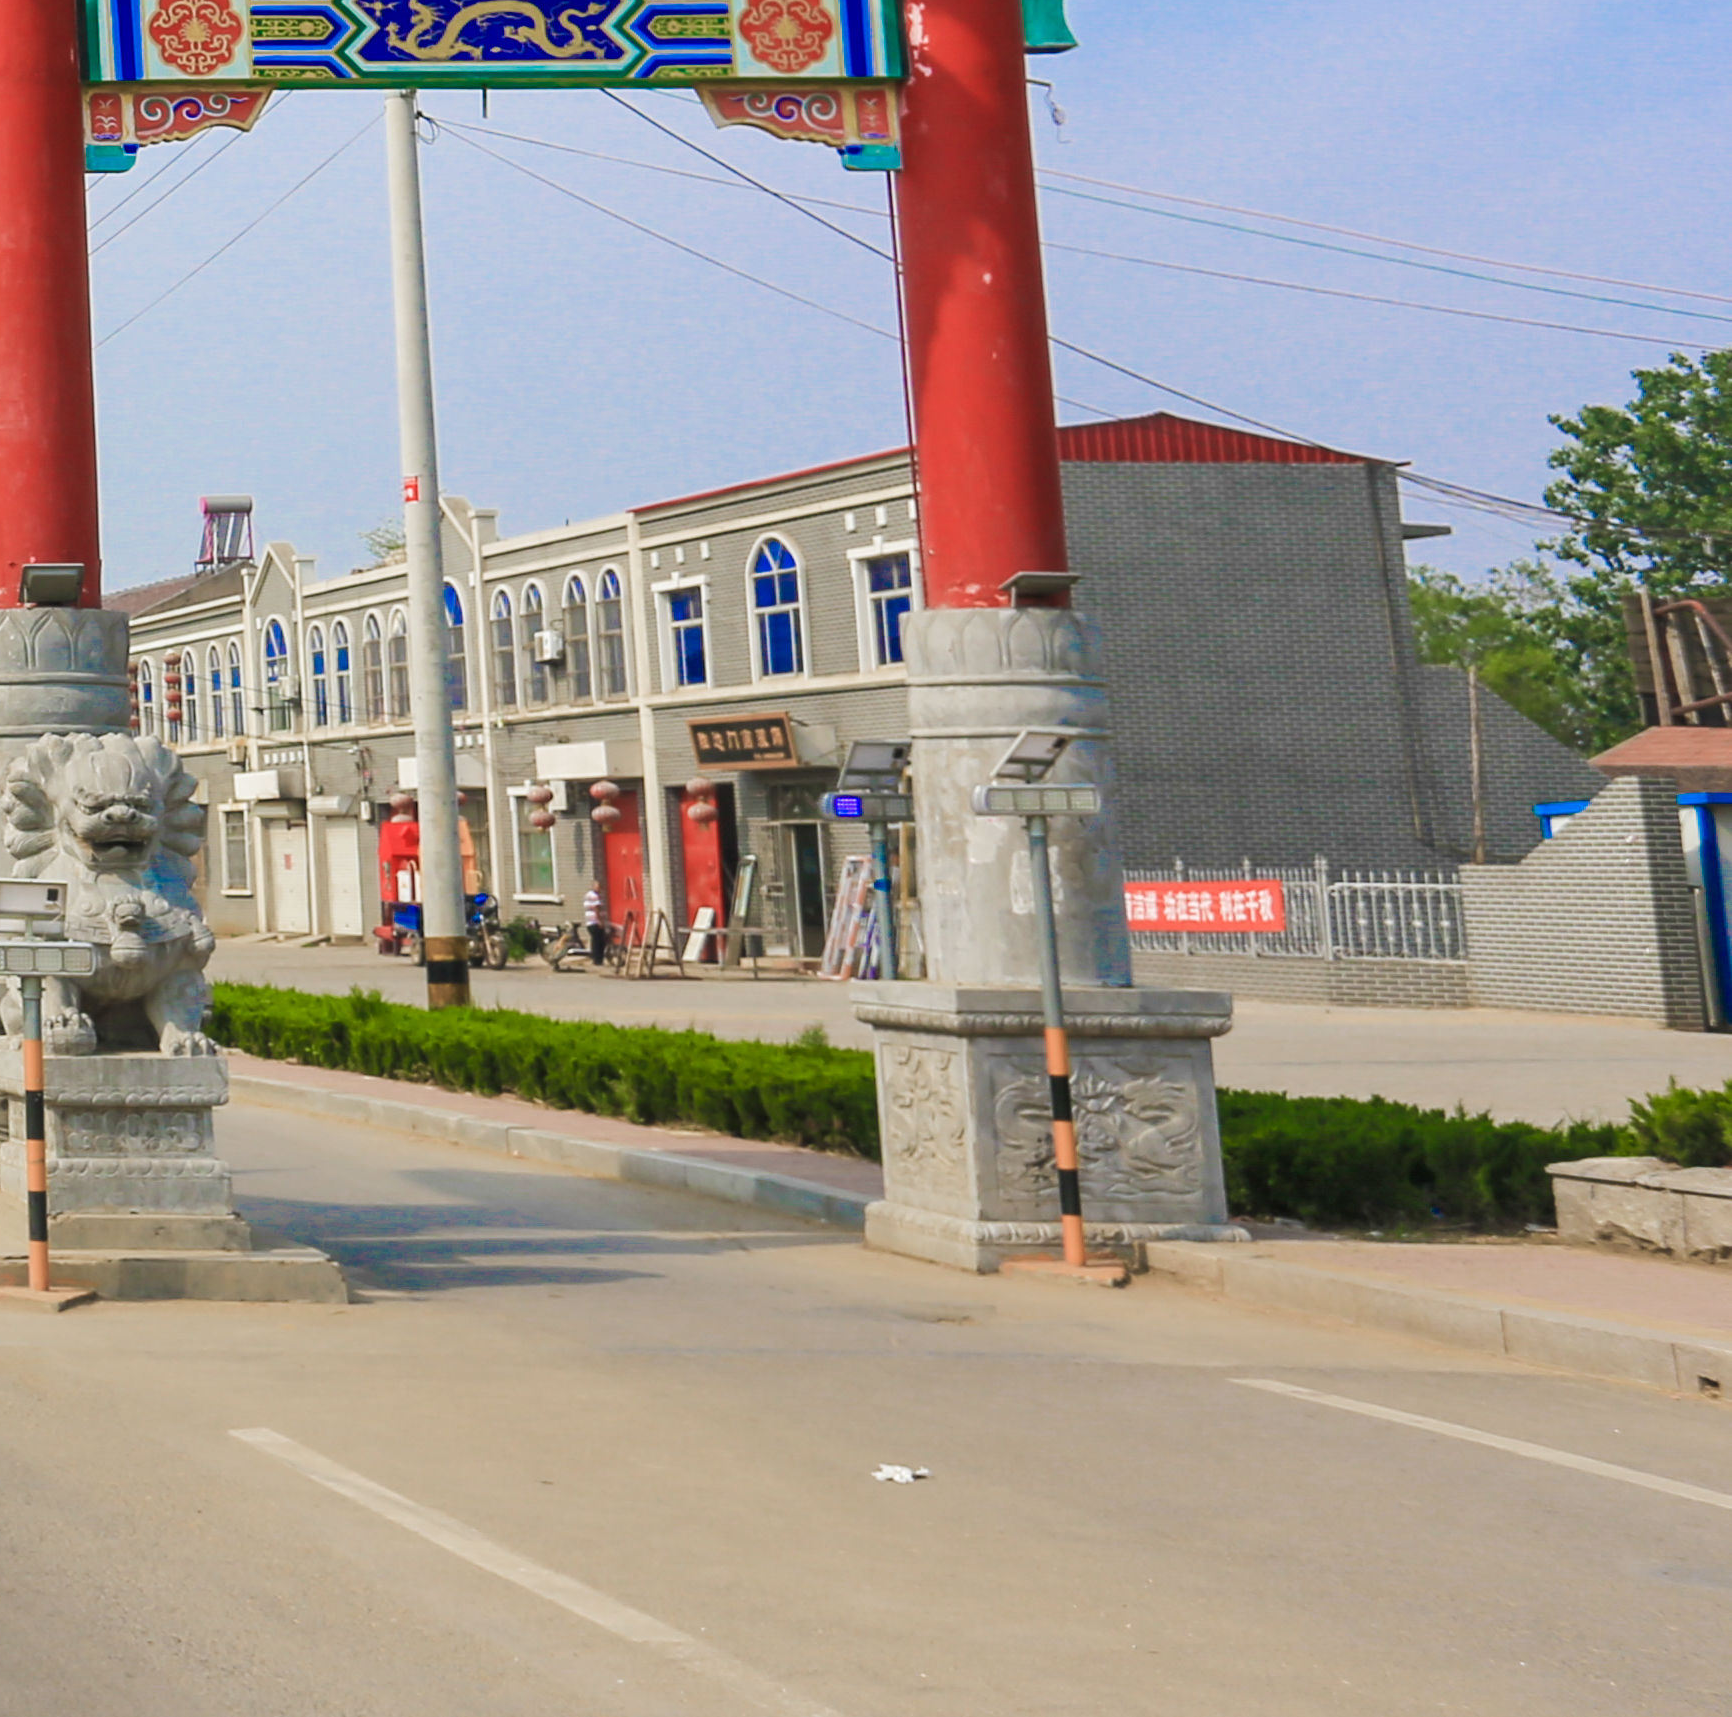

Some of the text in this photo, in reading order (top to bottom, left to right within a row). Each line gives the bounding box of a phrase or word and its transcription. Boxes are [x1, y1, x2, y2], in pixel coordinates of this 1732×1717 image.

[1163, 889, 1215, 923] 功在当代
[1218, 888, 1275, 923] 利在千秋
